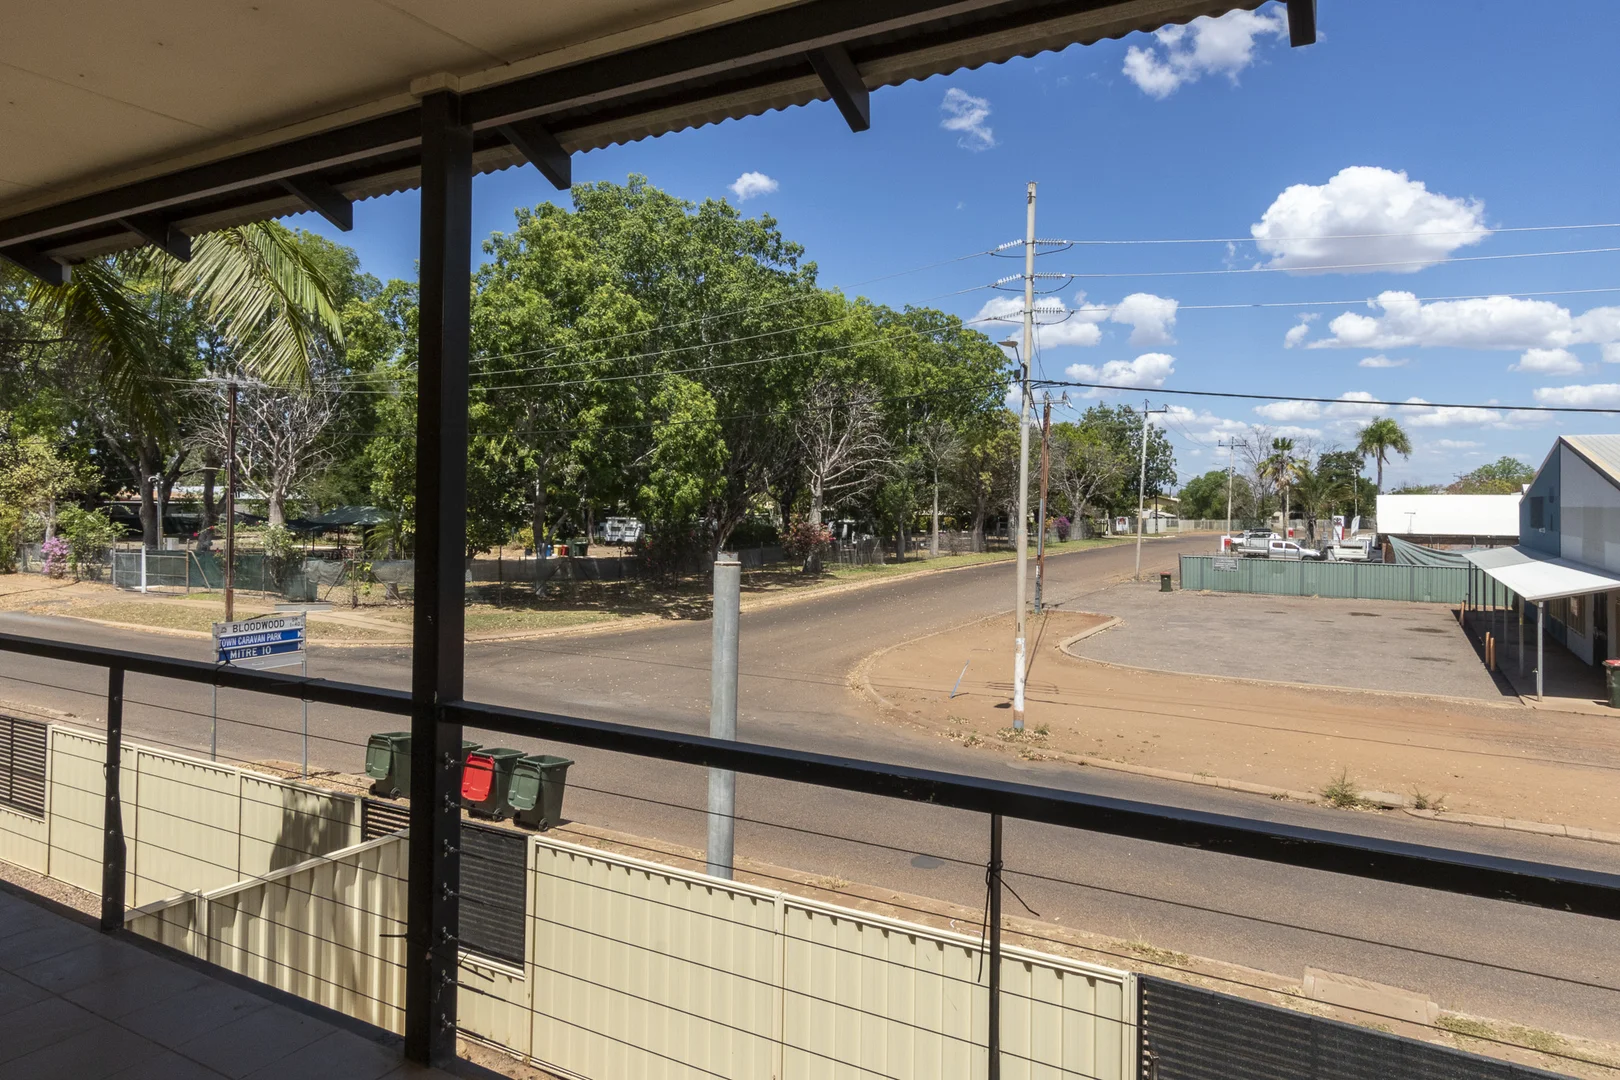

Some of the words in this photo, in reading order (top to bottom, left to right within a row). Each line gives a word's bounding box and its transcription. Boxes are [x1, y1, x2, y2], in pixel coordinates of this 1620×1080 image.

[232, 619, 285, 633] BLOODWOOD
[219, 637, 237, 648] TOWN
[238, 634, 266, 646] CARAVAN
[266, 632, 282, 642] PARK
[230, 647, 258, 659] MITRE
[262, 645, 272, 655] 10
